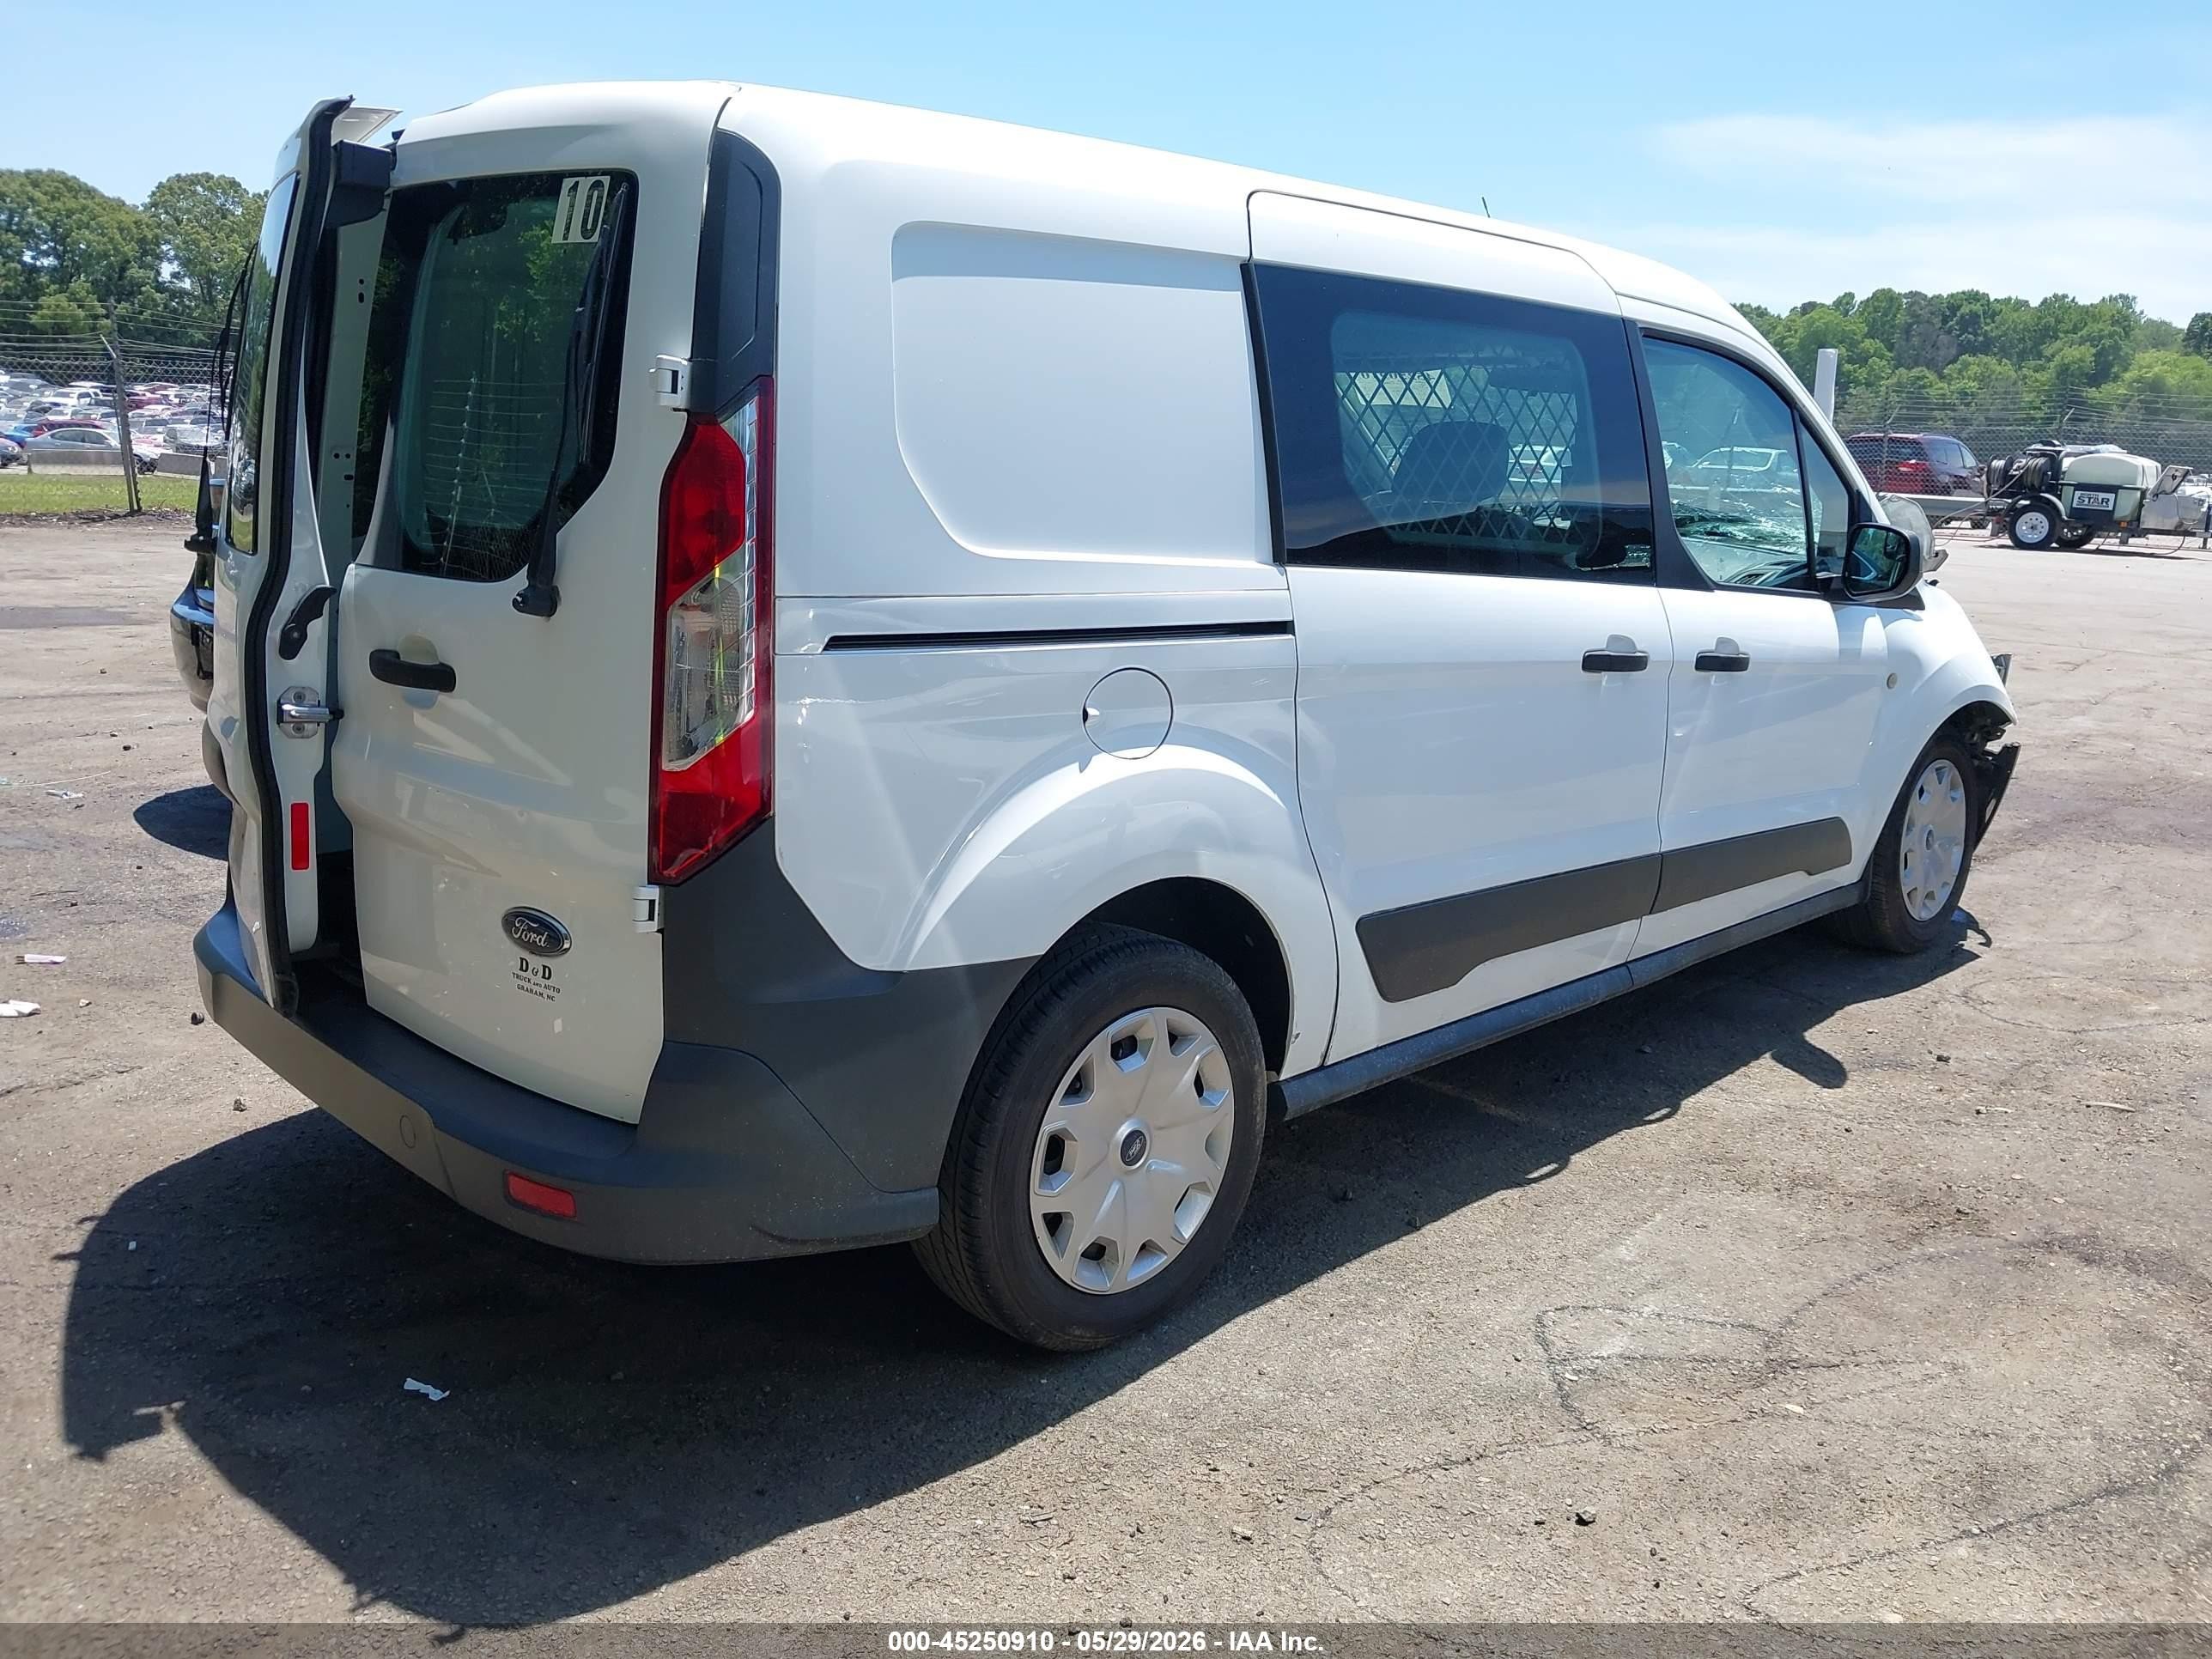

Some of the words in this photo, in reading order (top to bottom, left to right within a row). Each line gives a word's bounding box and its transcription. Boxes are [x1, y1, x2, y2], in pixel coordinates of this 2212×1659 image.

[562, 179, 605, 240] 10
[2076, 496, 2110, 505] STAR
[512, 917, 550, 947] Ford
[519, 957, 529, 972] D
[541, 964, 552, 981] D
[512, 972, 532, 984] TRUCK
[544, 983, 561, 994] AUTO
[517, 984, 545, 1000] GRAHAM,
[546, 994, 556, 1002] NC
